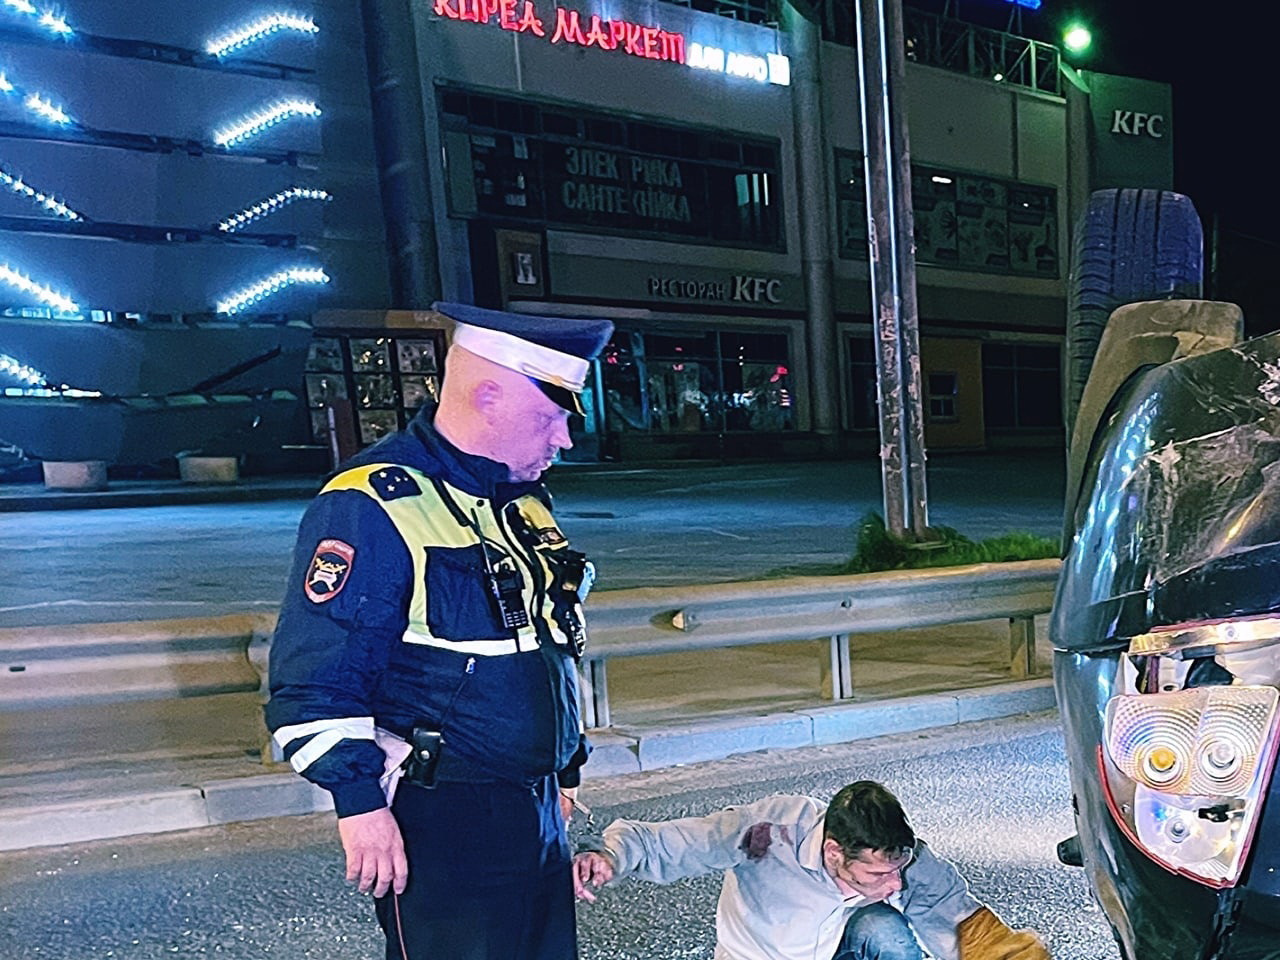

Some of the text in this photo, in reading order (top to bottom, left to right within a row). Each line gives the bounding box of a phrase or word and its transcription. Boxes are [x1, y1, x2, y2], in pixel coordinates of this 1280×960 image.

[551, 8, 685, 64] МАРКЕТ
[1111, 109, 1164, 138] KFC
[565, 146, 683, 189] ЭЛЕКРИКА
[651, 275, 782, 303] РЕСТОРАН KFC
